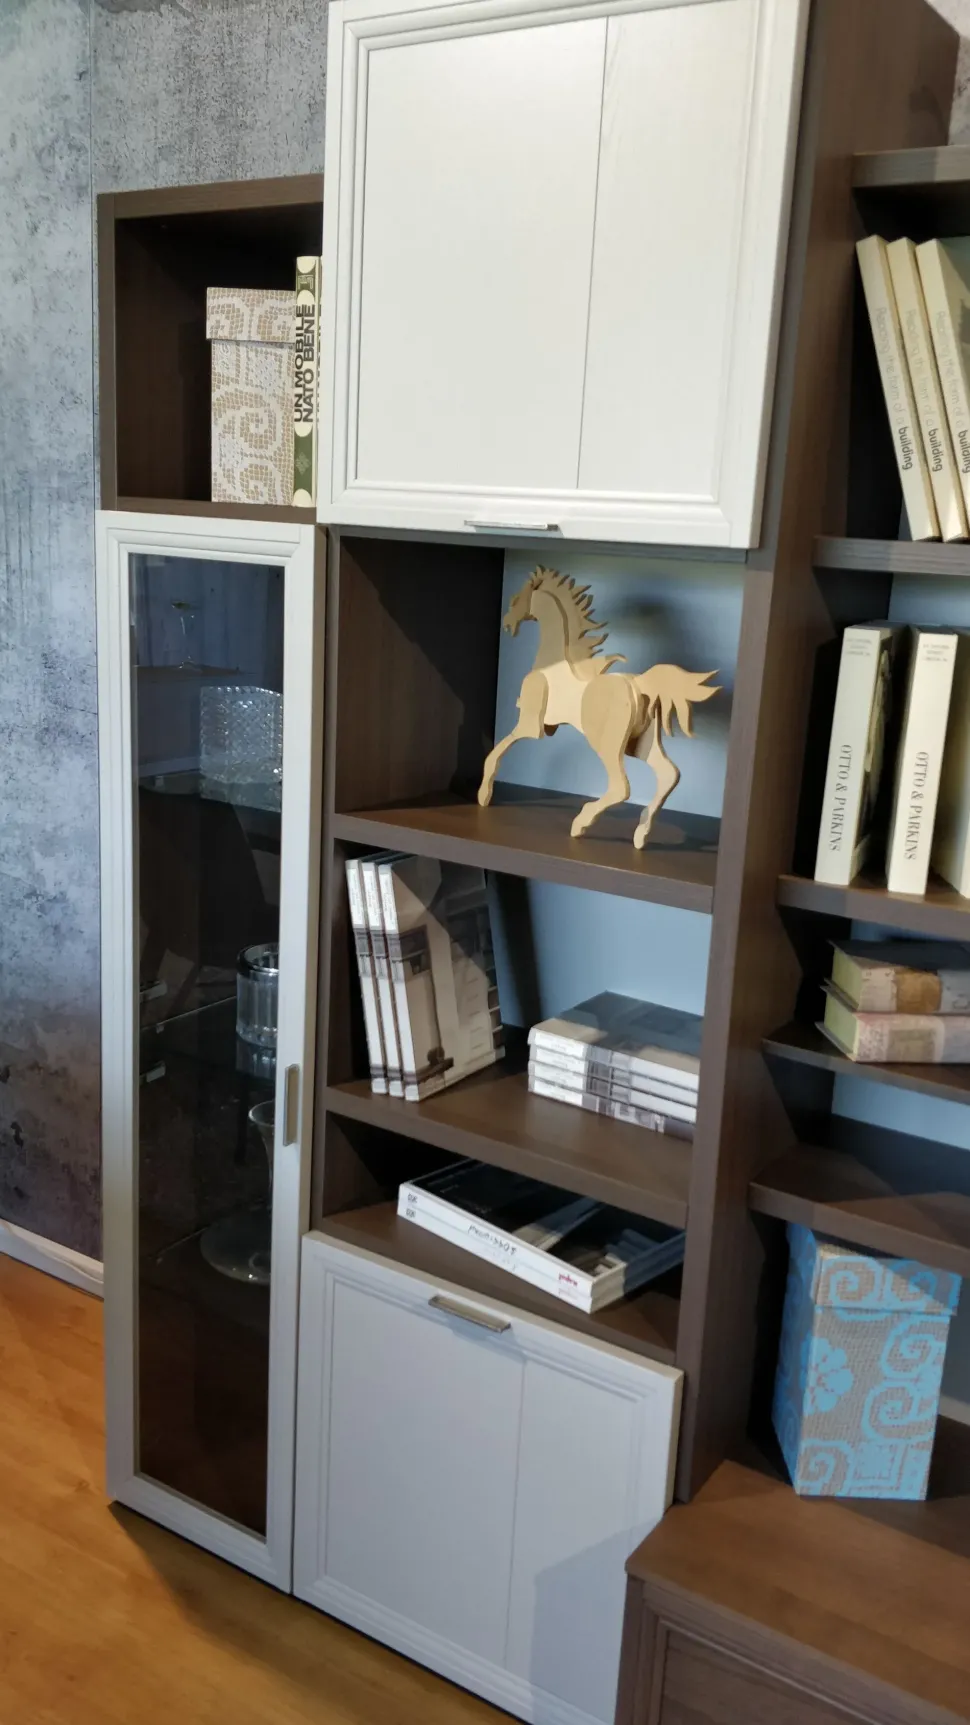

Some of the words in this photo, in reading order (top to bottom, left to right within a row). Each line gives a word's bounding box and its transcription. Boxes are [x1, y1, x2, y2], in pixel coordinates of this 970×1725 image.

[295, 304, 304, 388] MOBILE
[303, 304, 315, 361] BENE
[294, 393, 303, 423] UN
[302, 368, 314, 422] NATO
[899, 427, 913, 471] building
[927, 428, 943, 473] building
[837, 744, 852, 780] OTTO
[913, 751, 929, 788] OTTO
[835, 782, 848, 793] &
[911, 790, 925, 799] &
[829, 796, 847, 852] PARKINS
[904, 804, 923, 860] PARKINS
